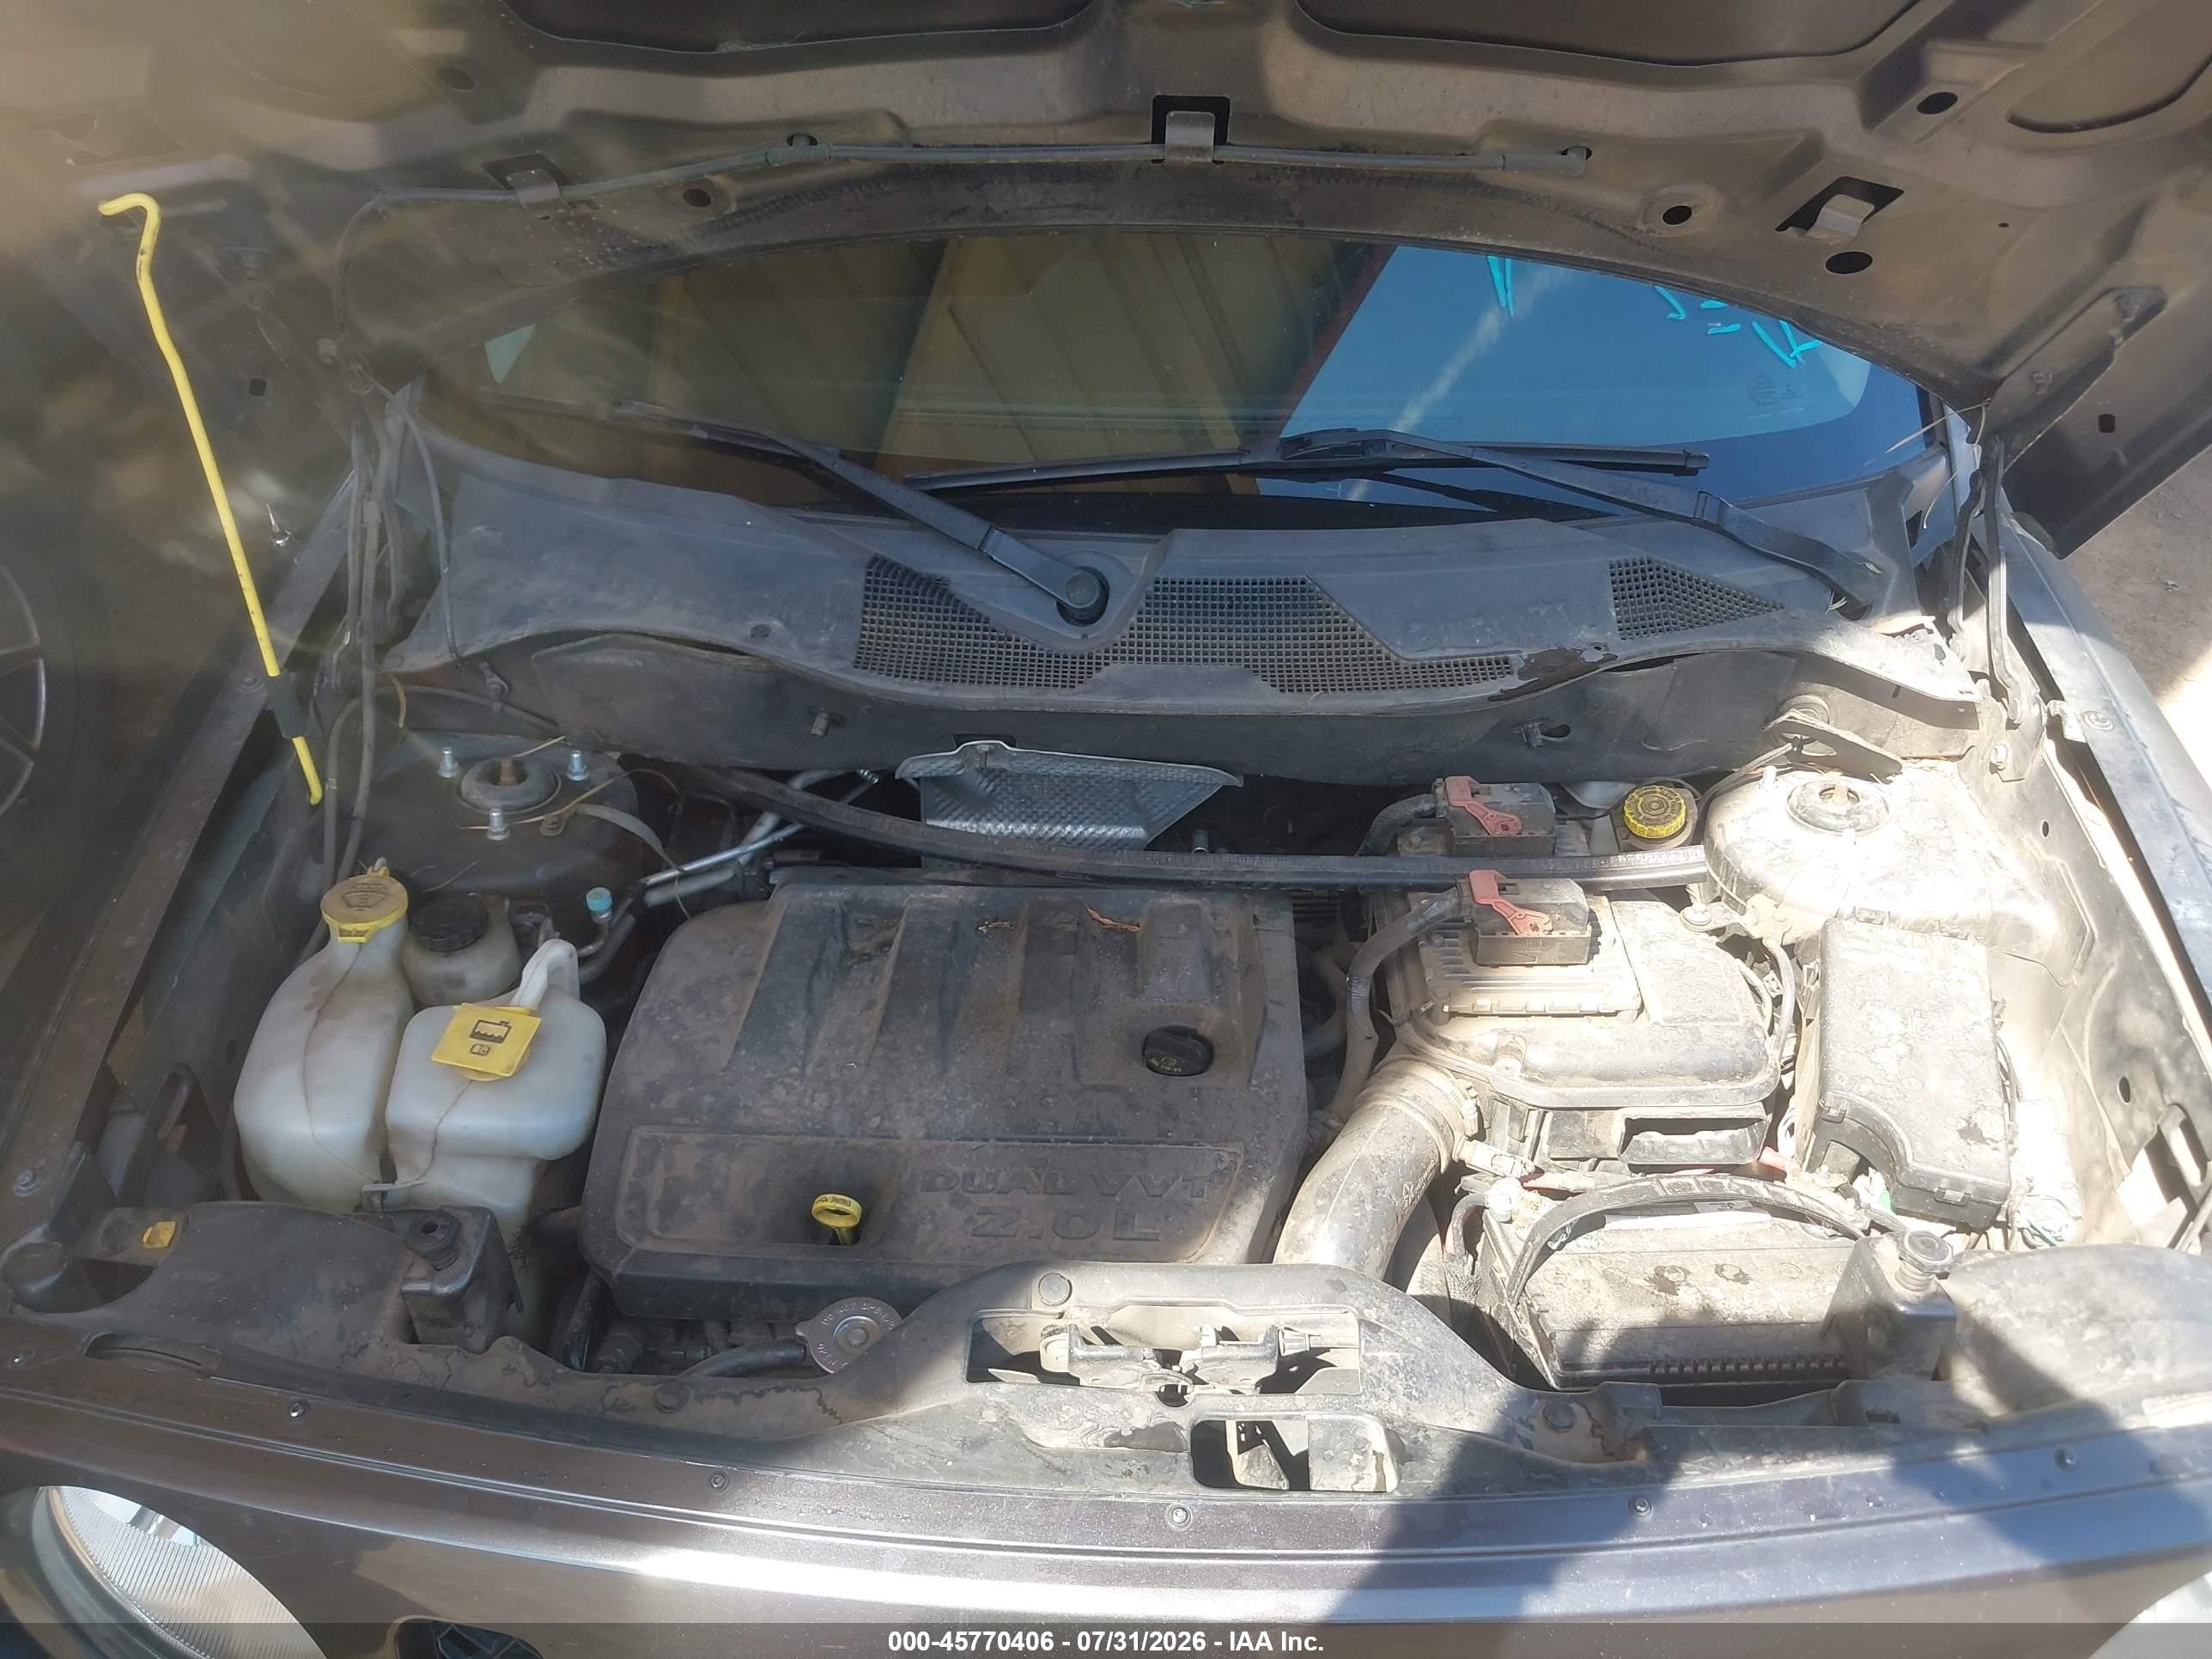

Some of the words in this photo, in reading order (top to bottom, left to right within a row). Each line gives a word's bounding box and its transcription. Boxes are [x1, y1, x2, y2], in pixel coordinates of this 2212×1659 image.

[919, 1170, 1079, 1196] DUAL
[1090, 1173, 1212, 1199] VVT
[969, 1206, 1162, 1242] 2.0L
